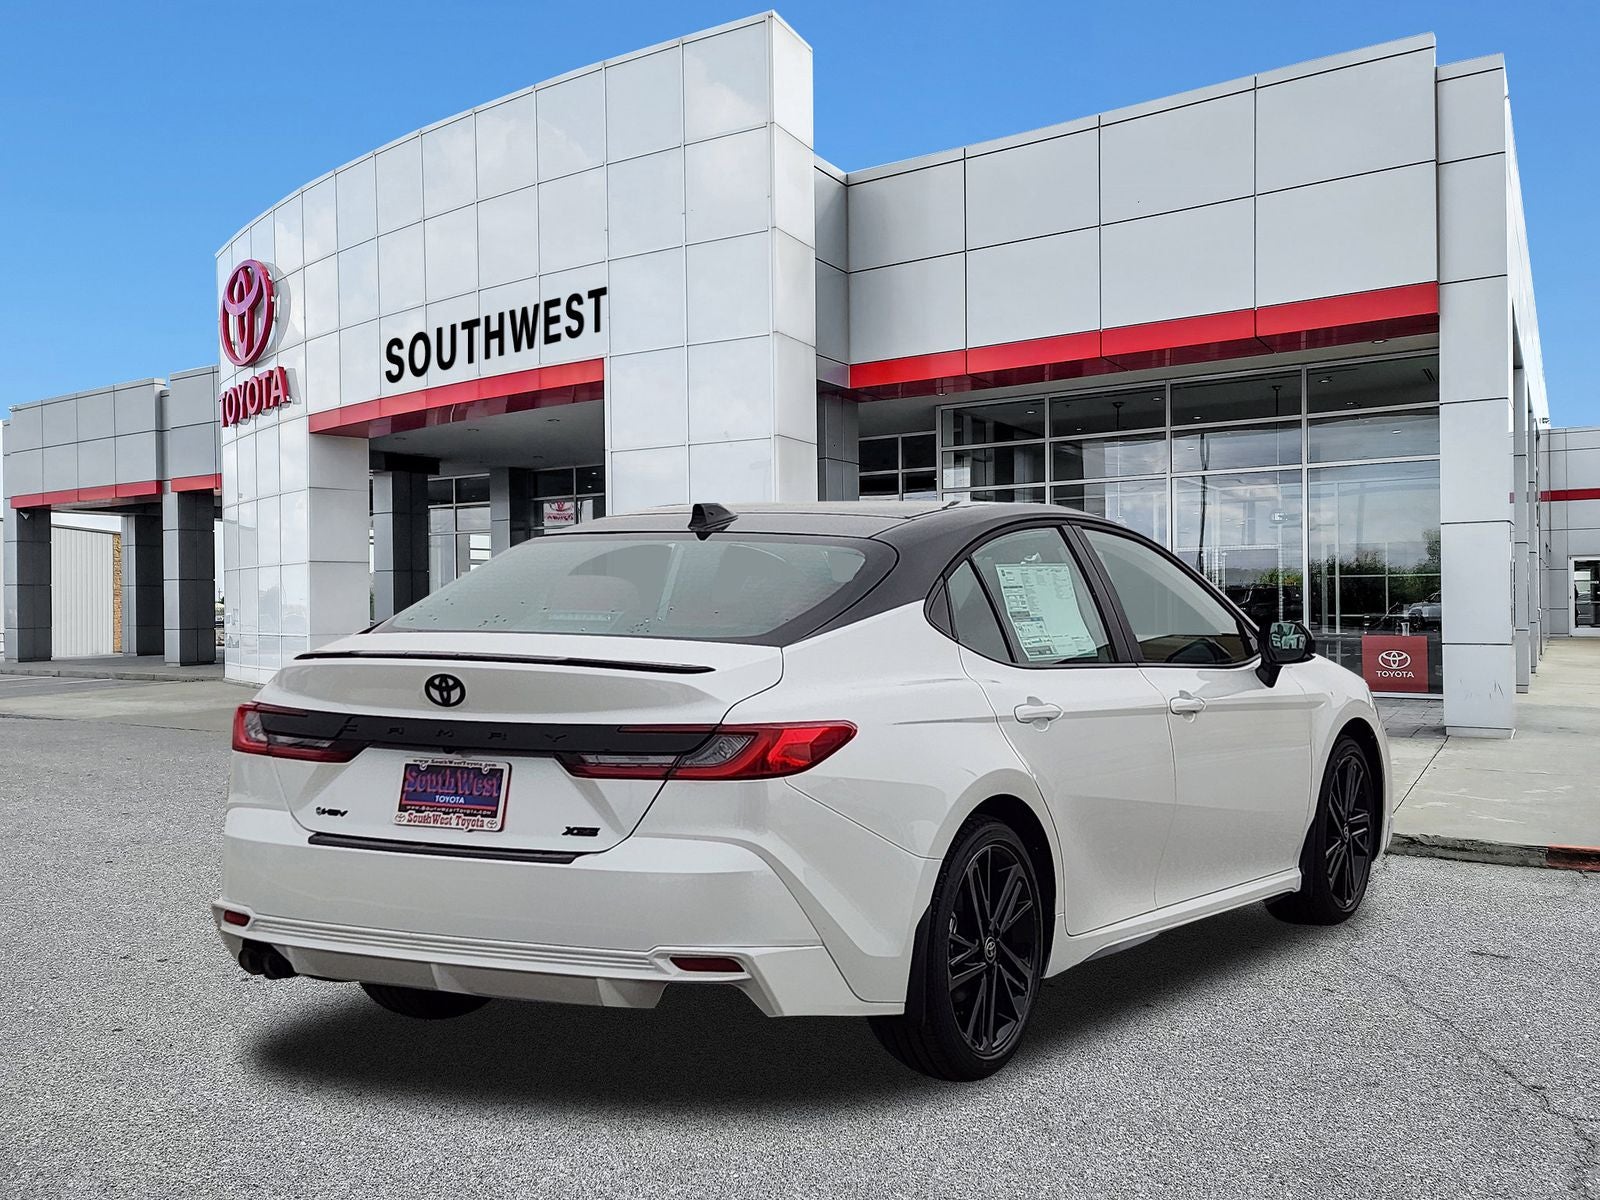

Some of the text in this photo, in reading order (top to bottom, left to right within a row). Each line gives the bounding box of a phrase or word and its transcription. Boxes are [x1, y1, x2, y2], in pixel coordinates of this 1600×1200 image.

[385, 287, 607, 383] SOUTHWEST
[218, 366, 291, 428] TOYOTA
[1376, 670, 1415, 678] TOYOTA
[435, 795, 465, 804] TOYOTA
[407, 812, 485, 829] SouthWest Toyota
